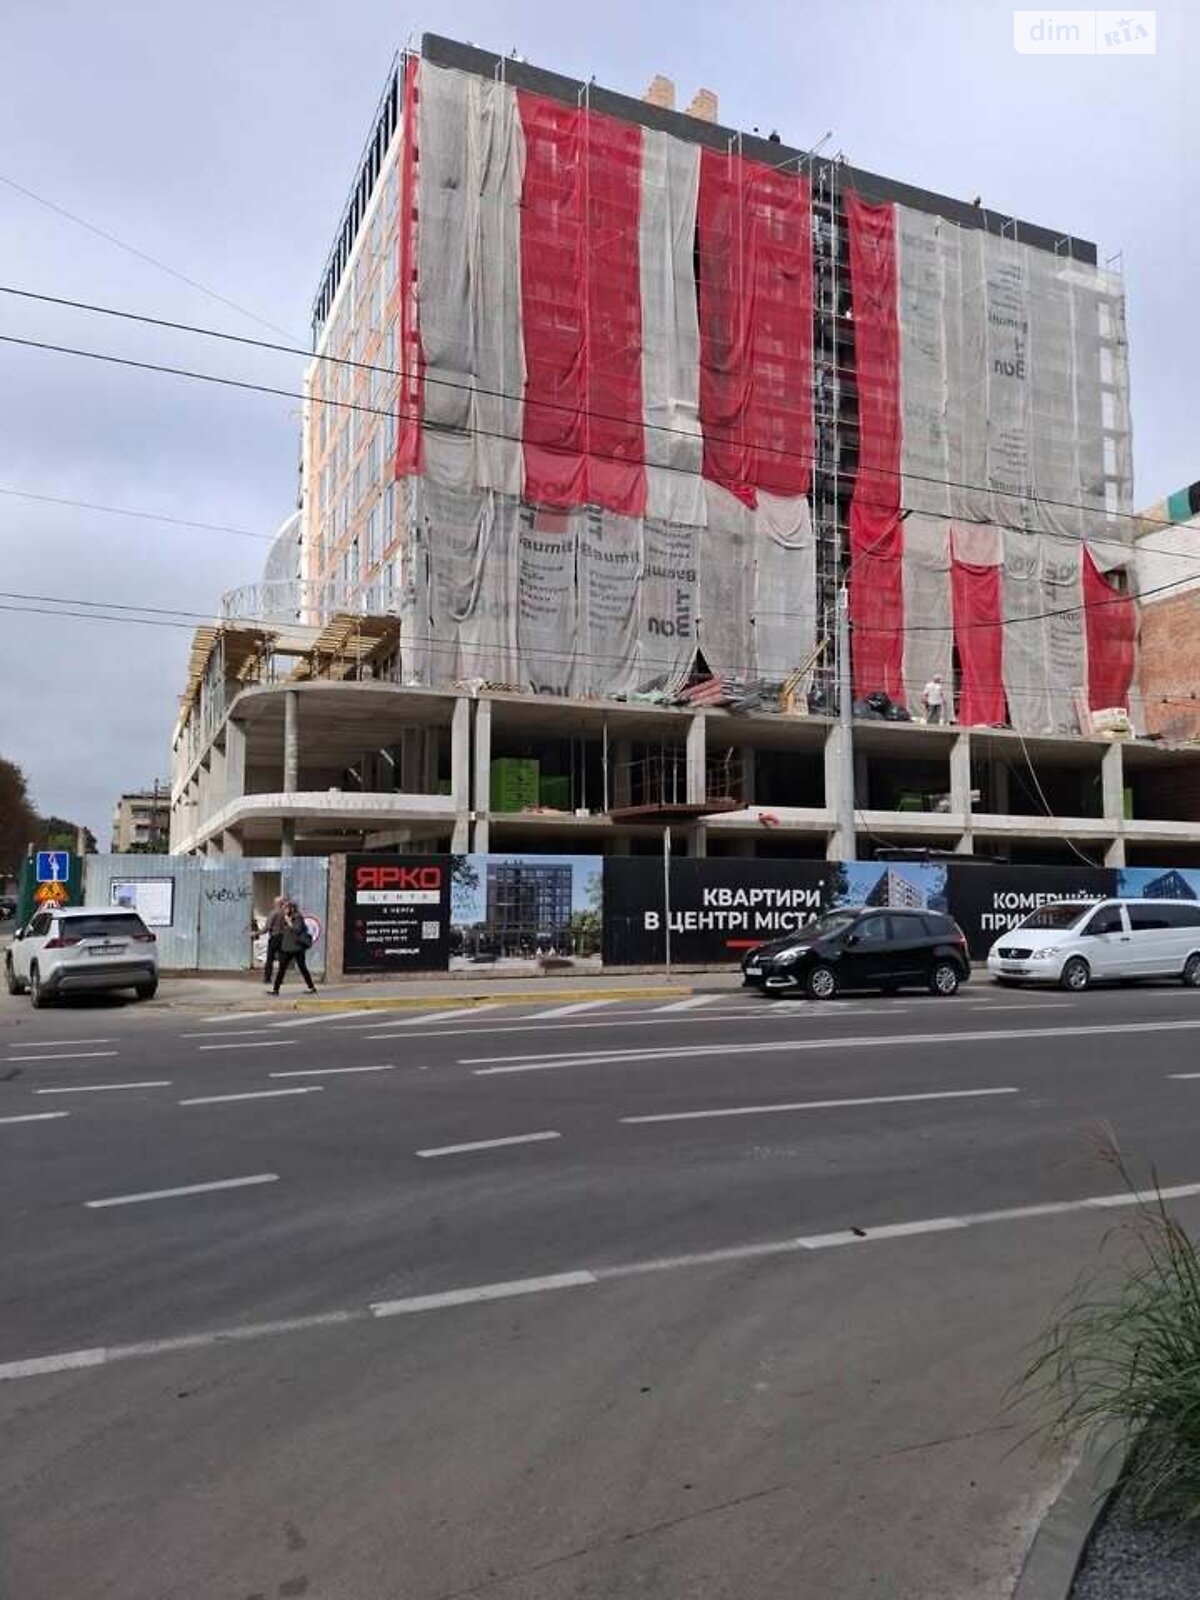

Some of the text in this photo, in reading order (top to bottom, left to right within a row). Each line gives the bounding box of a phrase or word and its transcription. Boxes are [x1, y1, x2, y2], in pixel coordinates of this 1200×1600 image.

[357, 867, 441, 889] ЯРКО
[703, 888, 821, 908] КВАРТИРИ
[644, 911, 660, 930] В
[669, 911, 748, 933] ЦЕНТРІ
